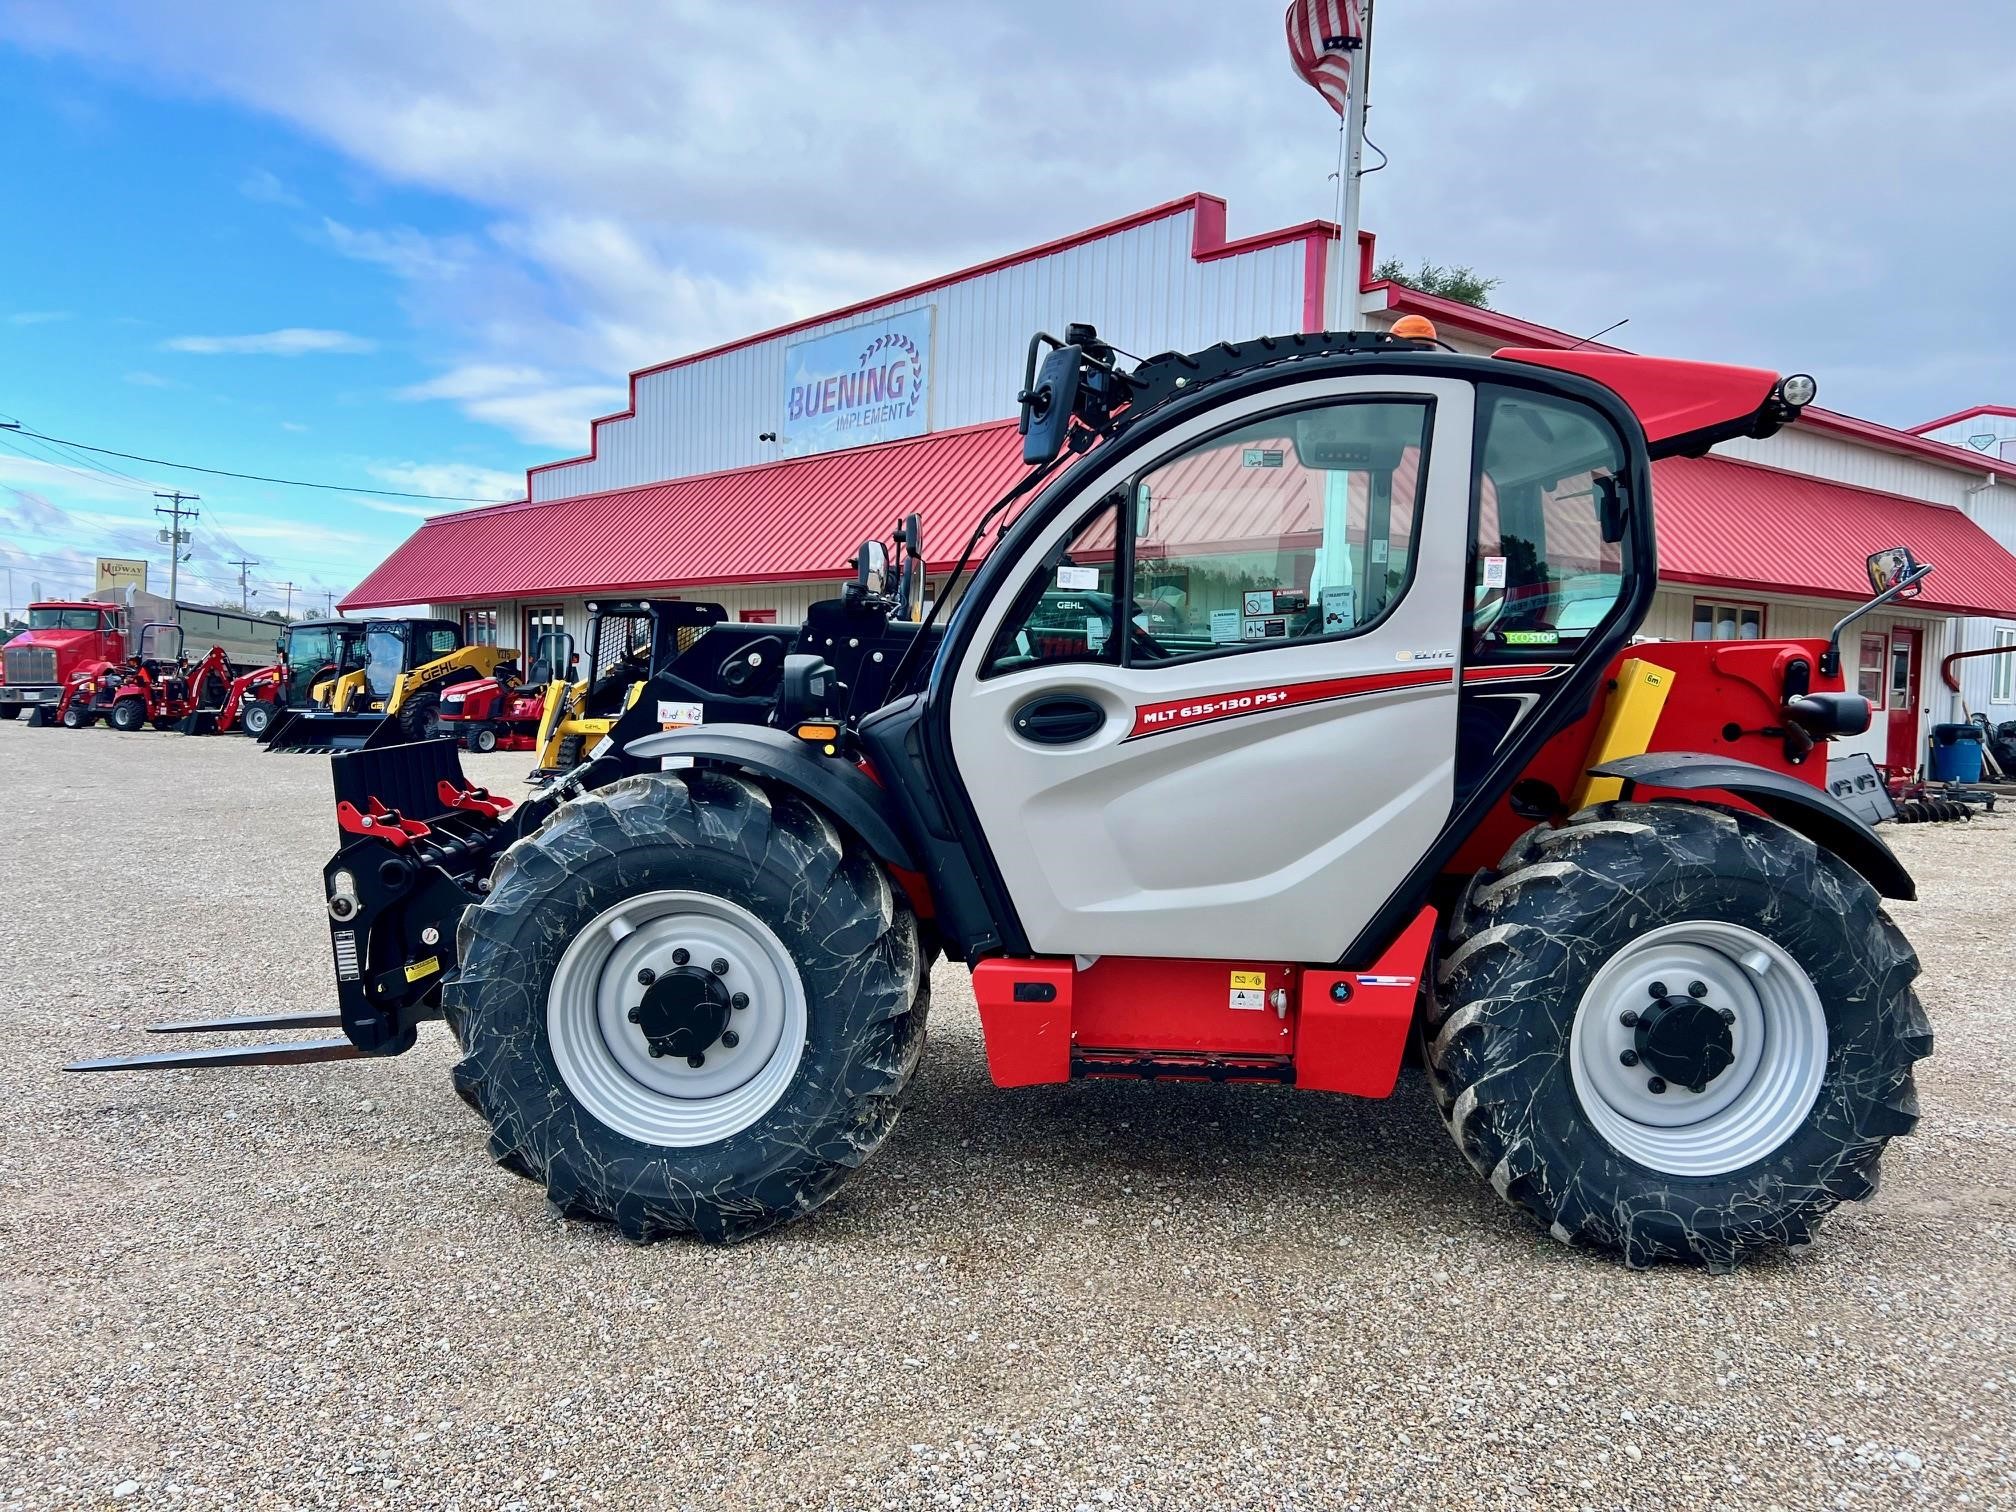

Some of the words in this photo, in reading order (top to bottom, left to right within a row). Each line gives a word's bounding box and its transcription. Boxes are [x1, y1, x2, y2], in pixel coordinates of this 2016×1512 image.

[788, 360, 906, 421] BUENING
[836, 402, 906, 431] IMPLEMENT
[1056, 601, 1084, 610] GEHL
[1511, 632, 1557, 642] ECOSTOP
[1413, 650, 1455, 660] ELITE
[421, 660, 458, 681] GEHL
[1647, 674, 1659, 685] 6m
[1143, 710, 1174, 723] MLT
[1180, 696, 1252, 718] 635-130
[1255, 690, 1288, 706] PS+
